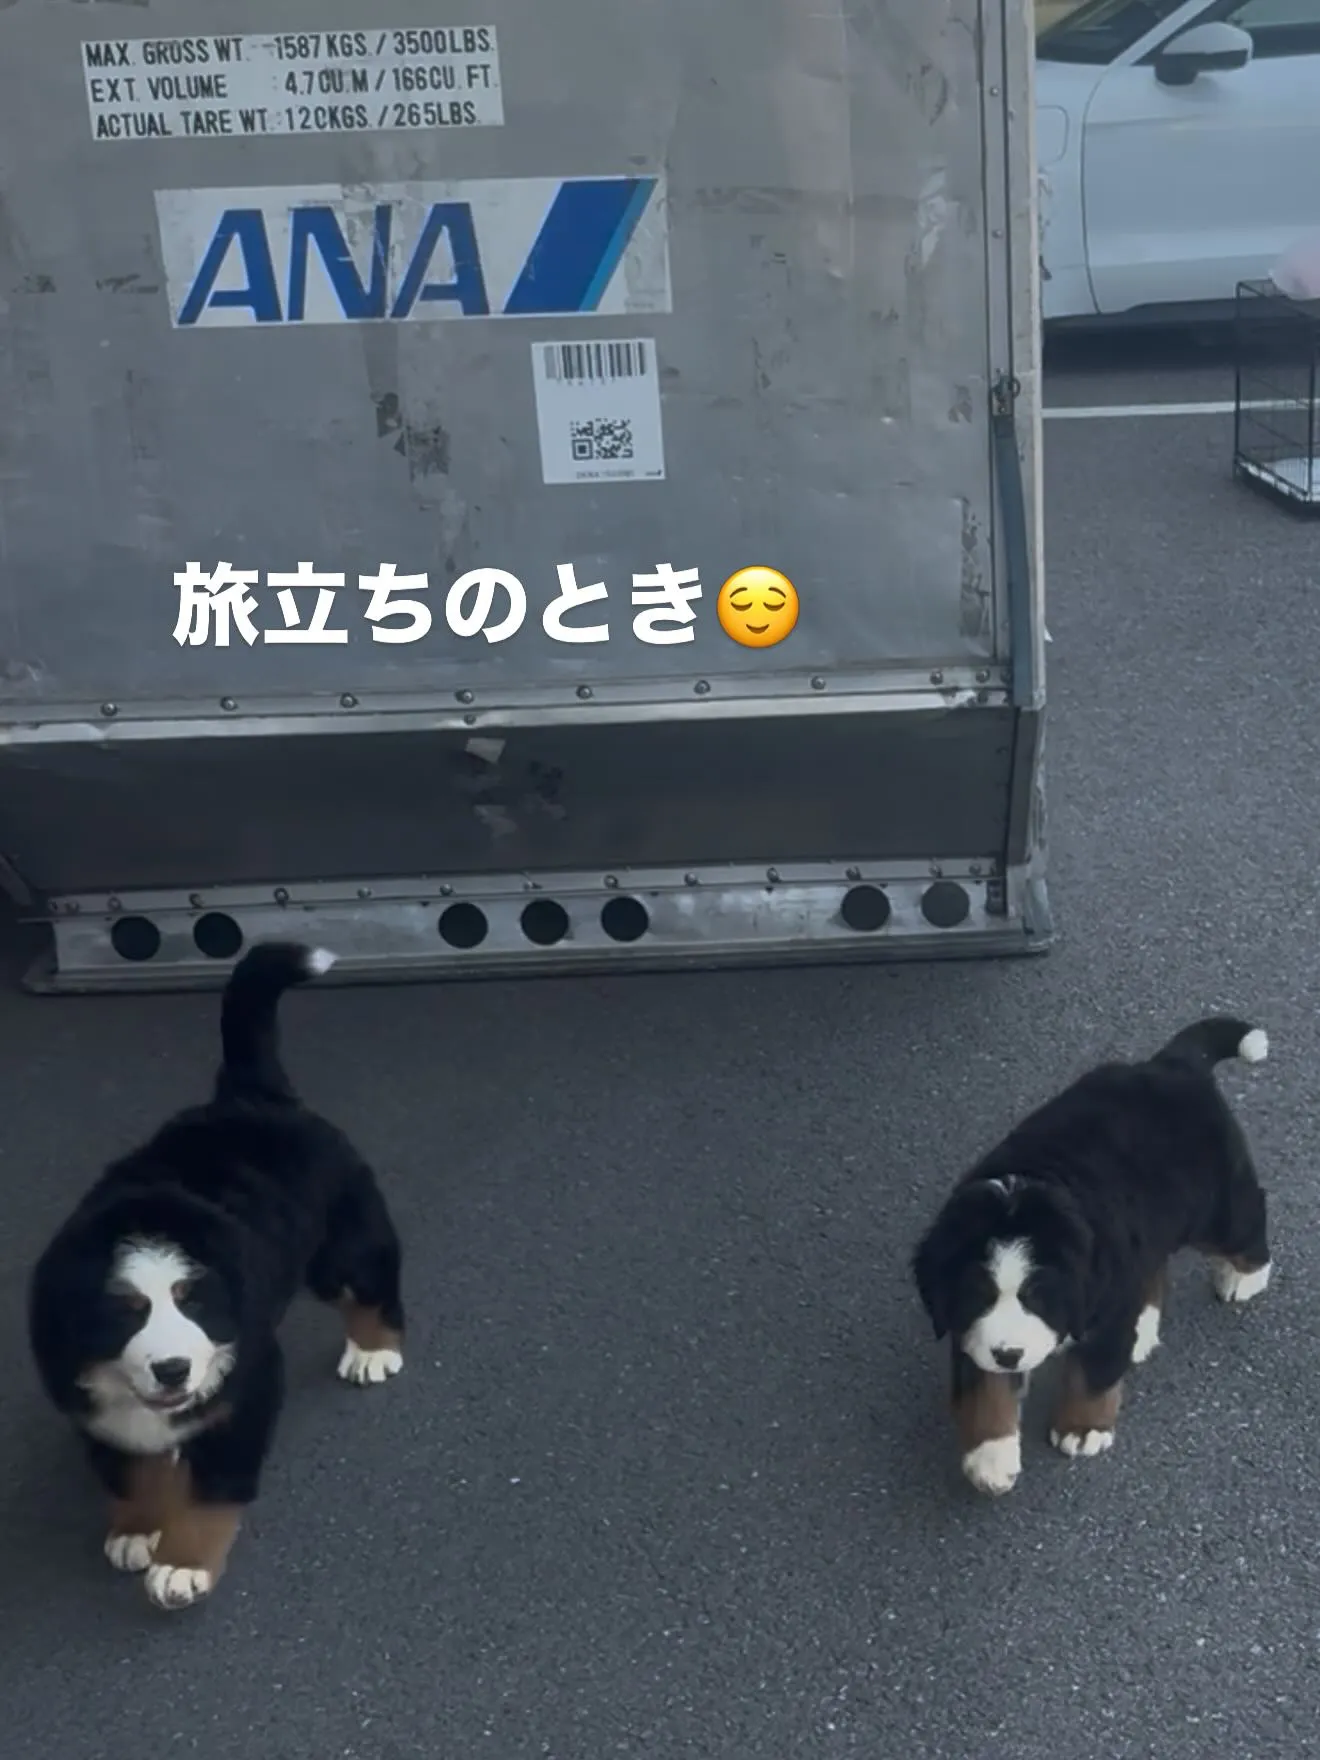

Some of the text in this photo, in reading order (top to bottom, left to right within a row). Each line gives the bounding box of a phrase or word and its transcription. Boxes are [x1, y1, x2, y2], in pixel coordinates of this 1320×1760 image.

[143, 39, 210, 65] GROSS
[147, 74, 228, 100] VOLUME
[96, 112, 172, 138] ACTUAL
[180, 109, 232, 135] TARE
[177, 202, 491, 325] ANA
